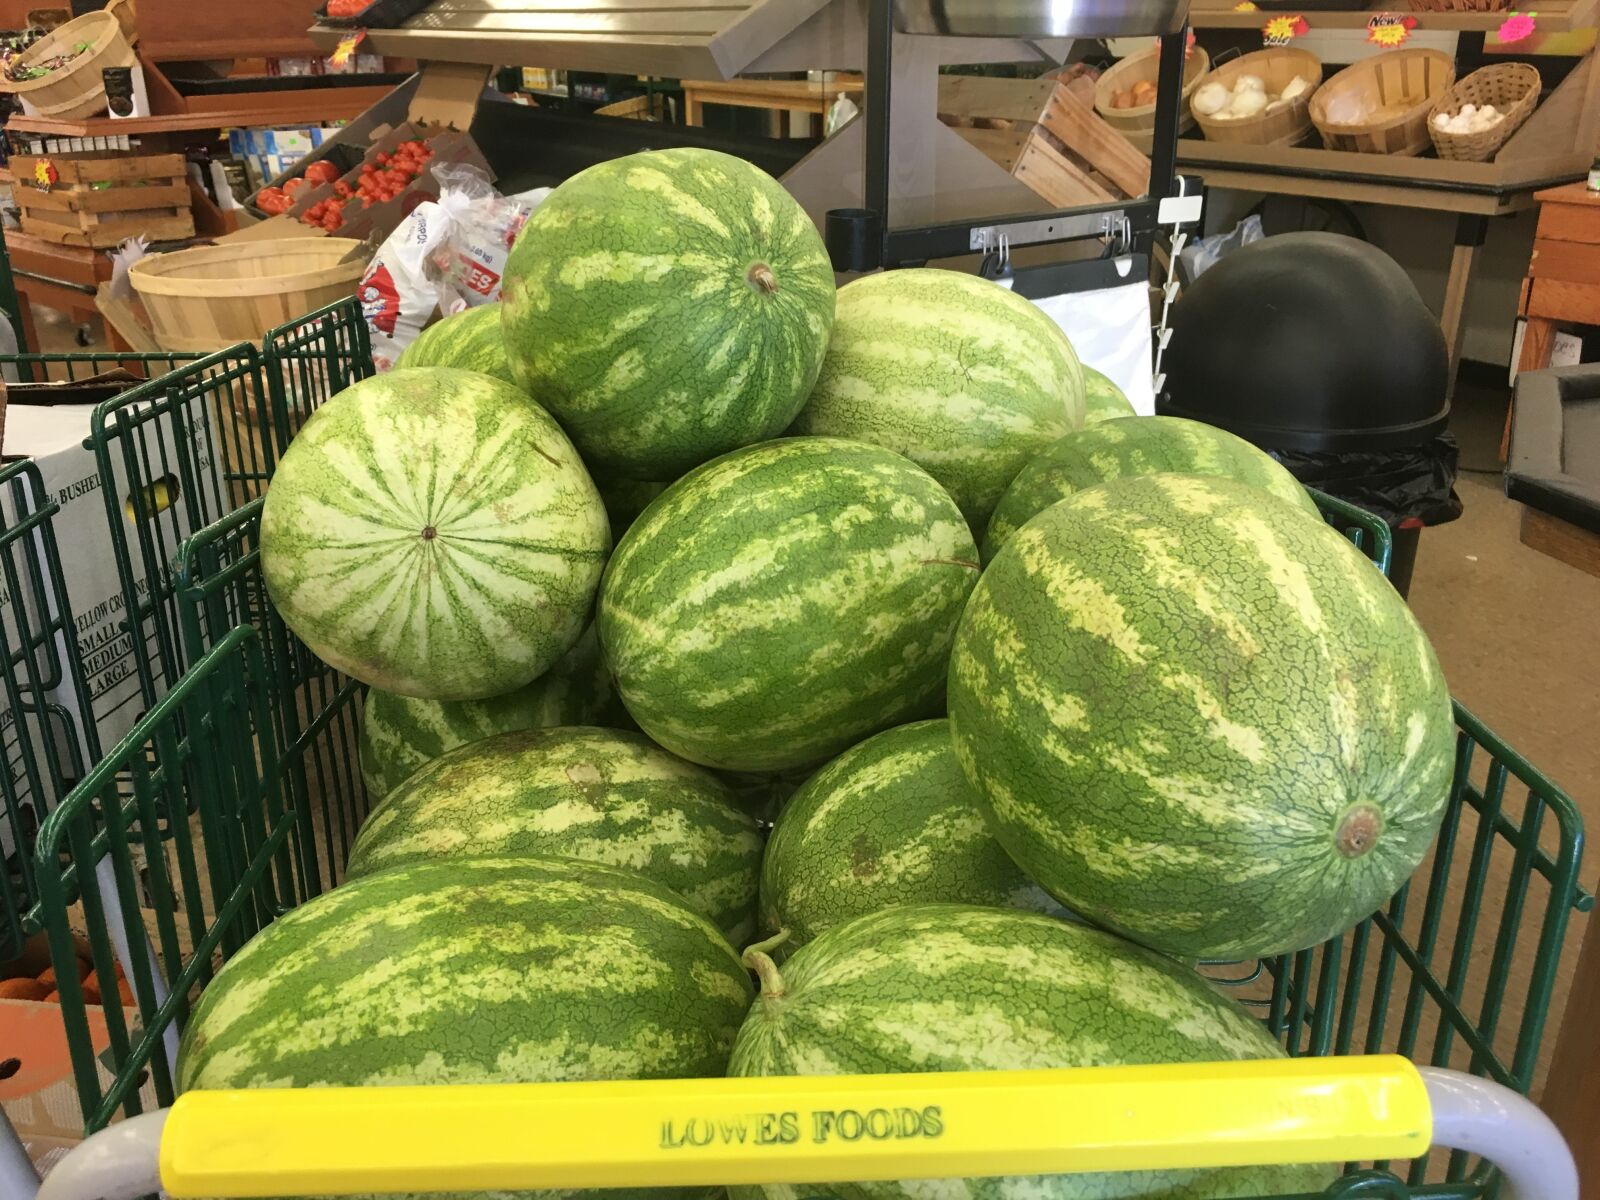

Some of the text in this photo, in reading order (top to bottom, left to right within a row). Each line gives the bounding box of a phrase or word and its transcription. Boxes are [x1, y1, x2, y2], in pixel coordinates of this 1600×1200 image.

[1264, 33, 1291, 46] Sale
[59, 473, 102, 504] BUSHEL
[77, 621, 119, 656] SMALL
[82, 633, 133, 676] MEDIUM
[90, 659, 130, 697] LARGE
[659, 1105, 944, 1149] LOWES FOODS
